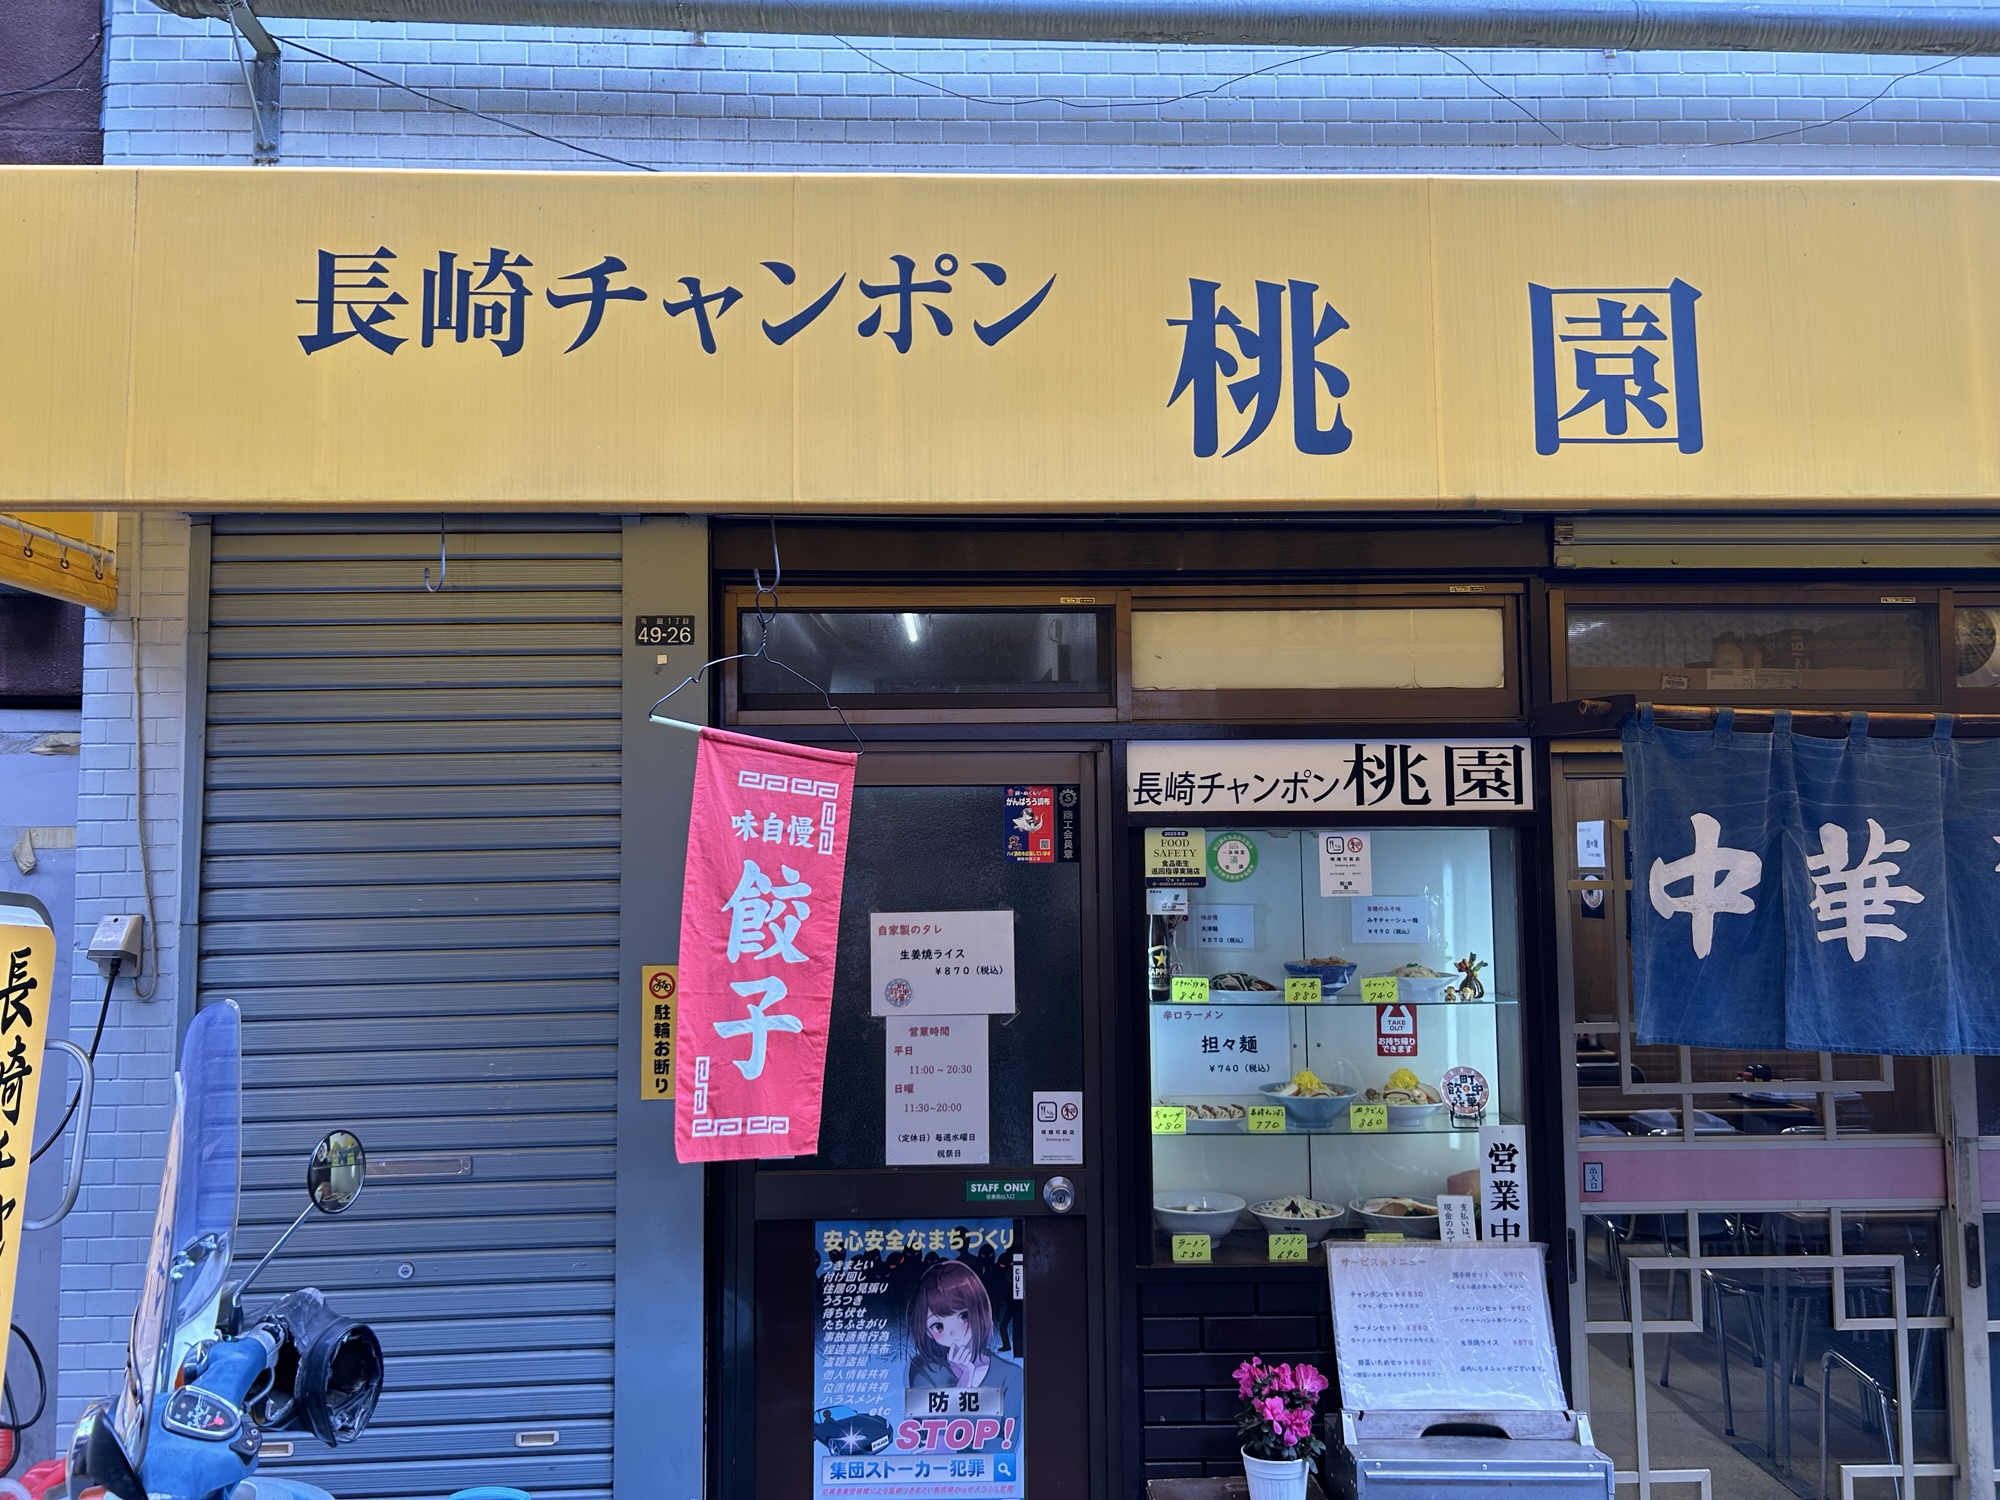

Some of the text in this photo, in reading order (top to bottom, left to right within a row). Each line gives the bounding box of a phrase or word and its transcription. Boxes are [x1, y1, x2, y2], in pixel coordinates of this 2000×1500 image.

[296, 246, 1704, 458] 長崎チャンポン 桃園
[638, 627, 691, 643] 49-26
[1133, 743, 1525, 807] 長崎チャンポン 桃園
[1006, 797, 1051, 806] がんばろう調布
[731, 809, 815, 848] 味自慢
[1063, 810, 1074, 859] 商工会員章
[1161, 839, 1190, 847] FOOD
[1153, 849, 1197, 857] SAFETY
[878, 924, 943, 936] 自家製のタレ
[713, 859, 813, 1080] 餃子
[1293, 992, 1318, 1001] 880
[1370, 992, 1394, 1001] 740
[1163, 1010, 1224, 1020] 辛口ラーメン
[909, 1026, 950, 1037] 営業時間
[1201, 1035, 1258, 1053] 担々麺
[1378, 1038, 1416, 1046] お持ち帰り
[654, 1004, 671, 1094] 駐輪お断り
[894, 1046, 913, 1056] 平日
[1382, 1045, 1413, 1053] できます
[909, 1064, 935, 1075] 11:00
[946, 1064, 972, 1075] 20:30
[895, 1084, 914, 1094] 日曜
[1256, 1121, 1280, 1129] 770
[1359, 1119, 1382, 1128] 860
[937, 1149, 961, 1158] 祝祭日
[1590, 1166, 1598, 1189] 出入口
[971, 1183, 1030, 1192] STAFF ONLY
[1488, 1143, 1521, 1242] 営業中
[1460, 1203, 1472, 1239] 支払いは、
[823, 1229, 1014, 1252] 安心安全なまちづくり
[1278, 1249, 1299, 1259] 690
[823, 1259, 874, 1270] つきまとい
[823, 1271, 867, 1283] 付け回し
[823, 1283, 889, 1294] 住居の見張り
[823, 1295, 863, 1306] うろつき
[823, 1307, 867, 1319] 待ち伏せ
[823, 1319, 888, 1330] たちふさがり
[823, 1369, 890, 1380] 個人情報共有
[823, 1394, 884, 1405] ハラスメント
[928, 1391, 980, 1413] 防犯
[896, 1418, 1015, 1450] STOP!
[830, 1458, 985, 1480] 集団ストーカー犯罪
